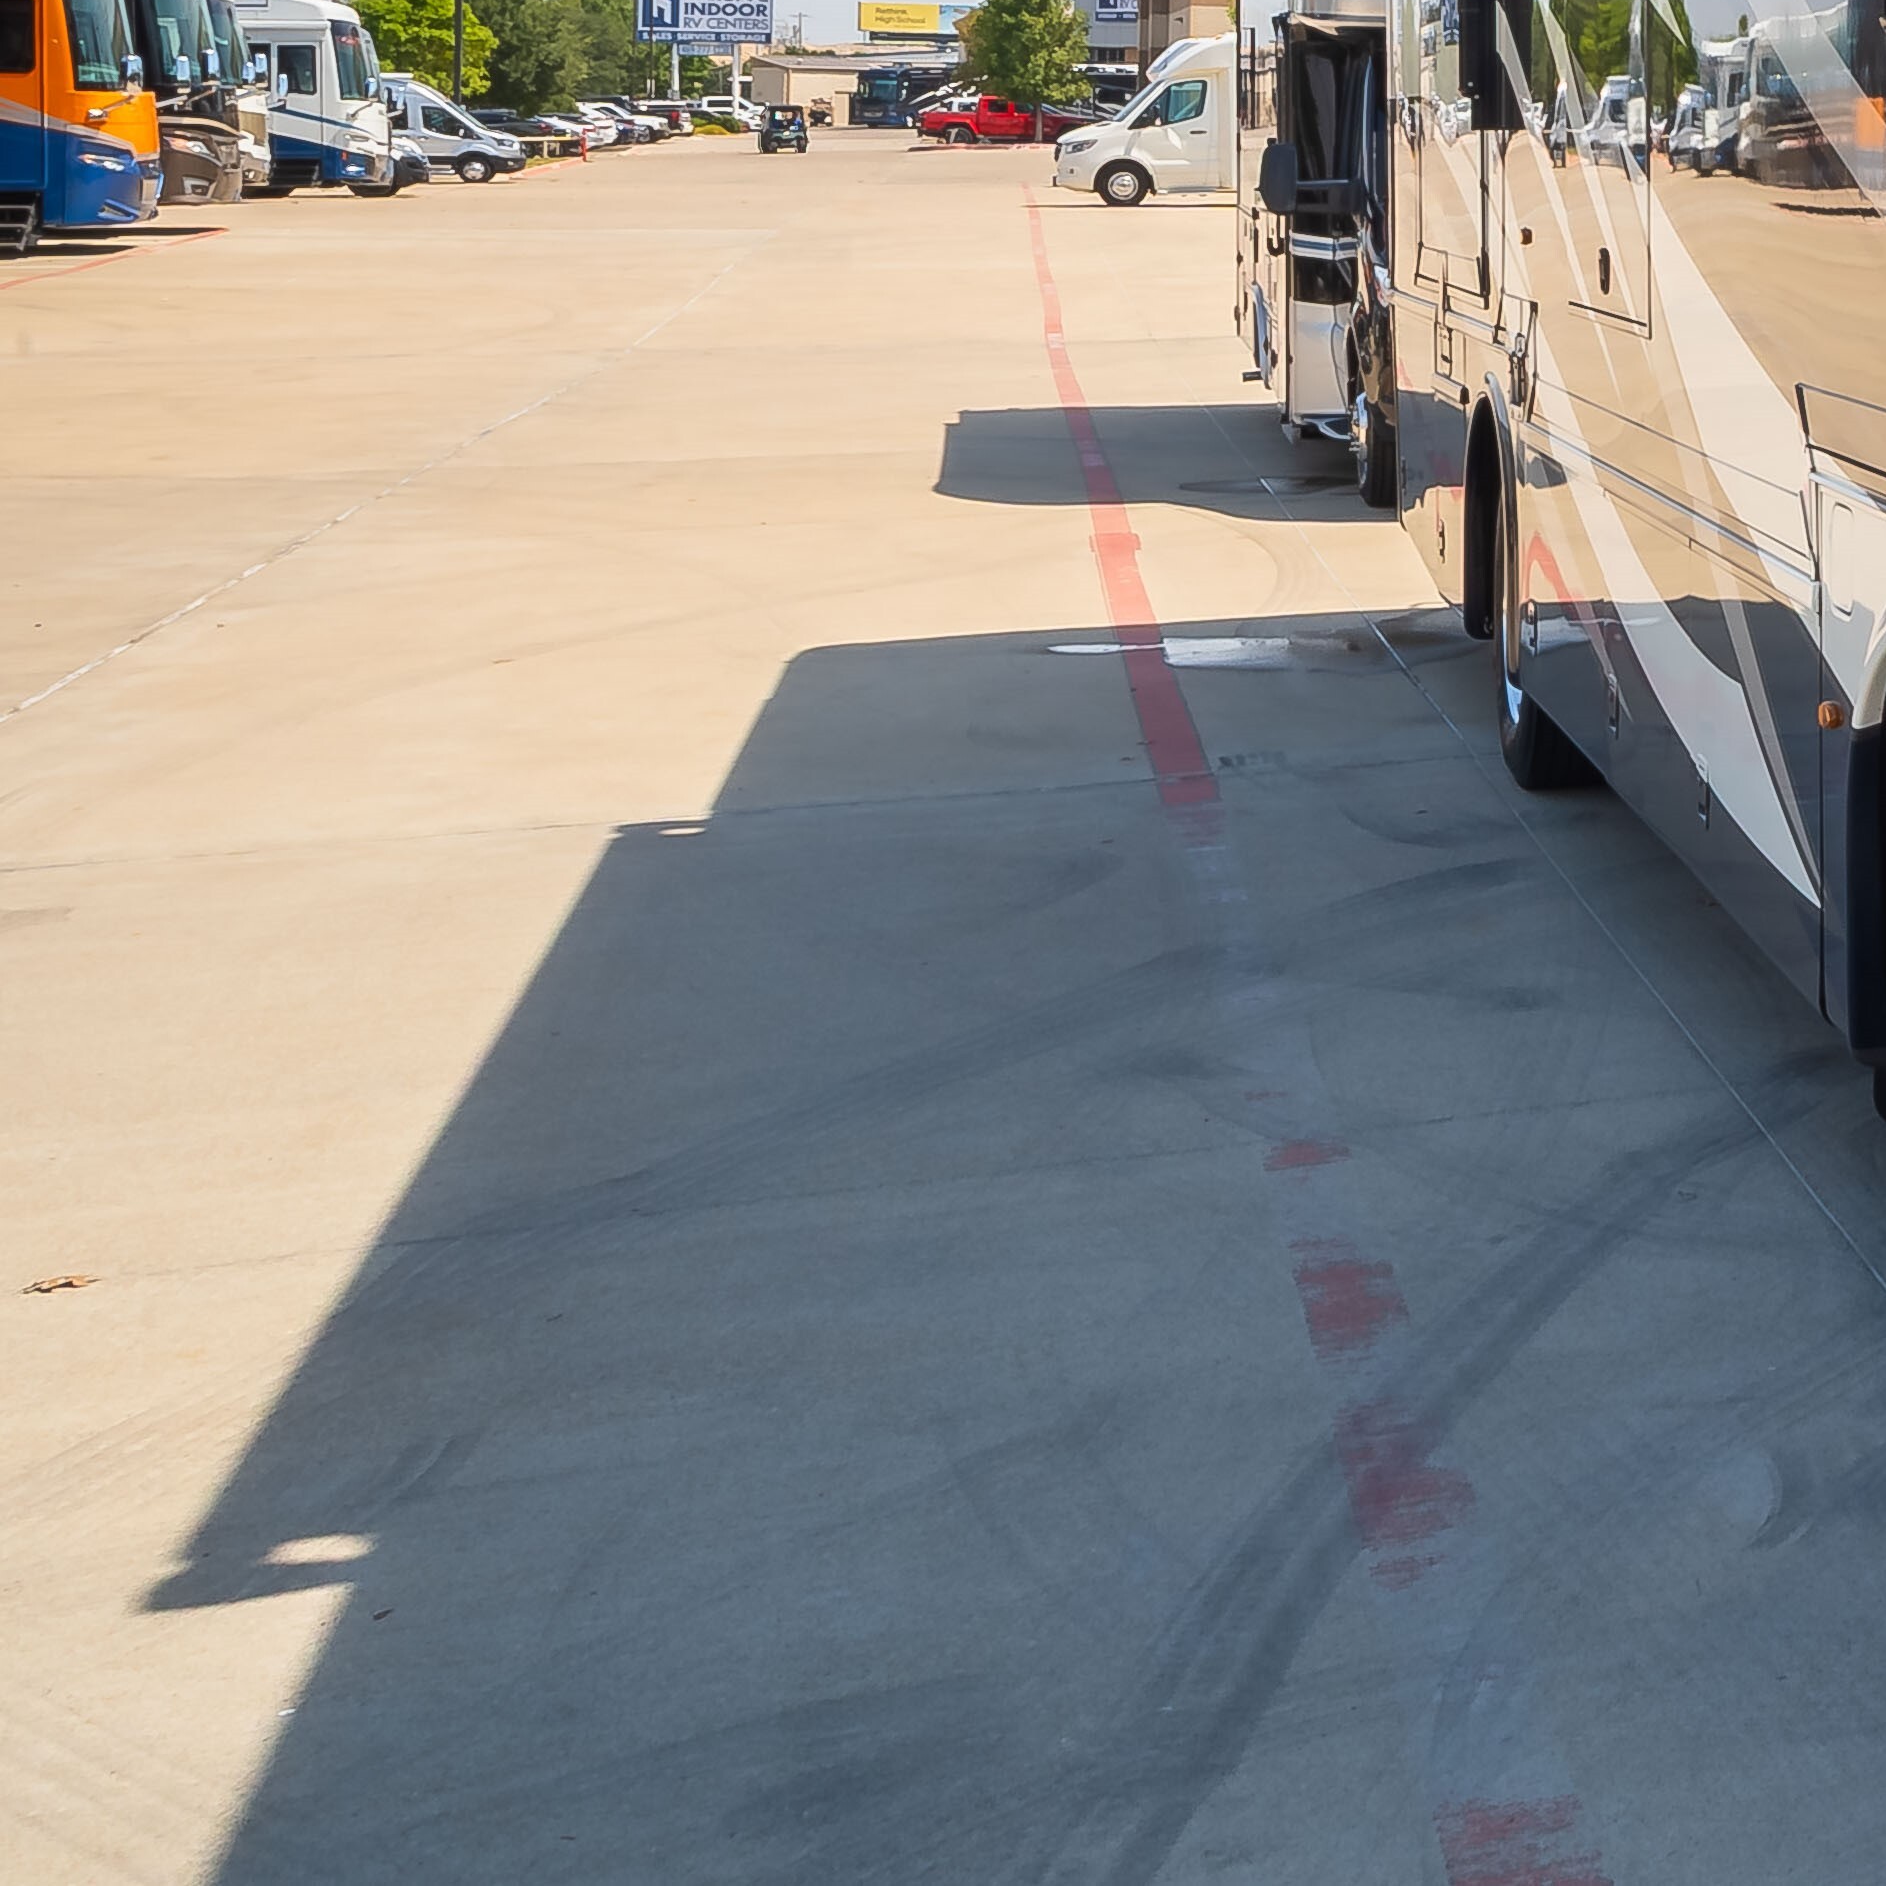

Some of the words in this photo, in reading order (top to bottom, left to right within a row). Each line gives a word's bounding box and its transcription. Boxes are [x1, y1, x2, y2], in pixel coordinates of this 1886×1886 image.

[684, 3, 768, 17] INDOOR
[683, 17, 703, 29] RV
[706, 18, 769, 30] CENTERS
[643, 32, 672, 41] SLES
